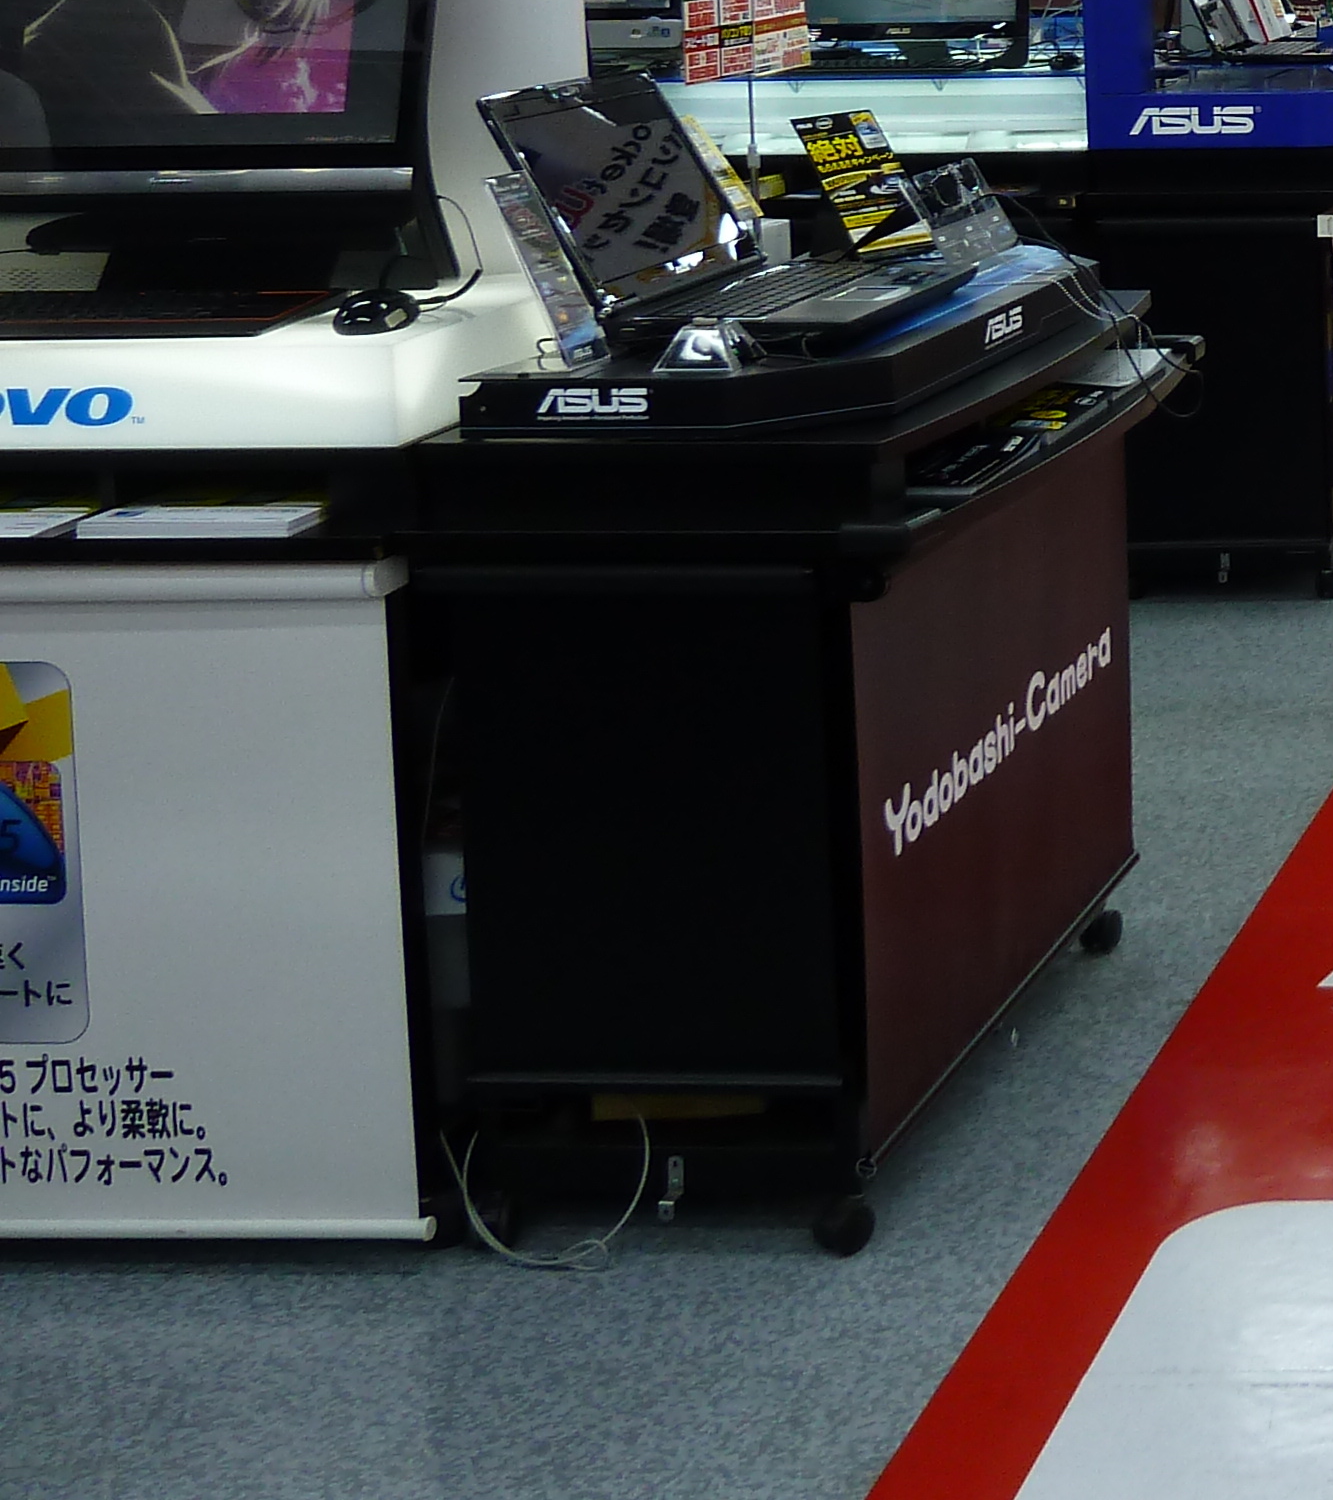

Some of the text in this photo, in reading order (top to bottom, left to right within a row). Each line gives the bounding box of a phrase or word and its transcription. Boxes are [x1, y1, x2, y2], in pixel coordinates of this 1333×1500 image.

[1129, 105, 1255, 136] ASUS
[806, 134, 864, 163] 絶対
[985, 307, 1024, 340] ASUS
[537, 388, 650, 414] ASUS
[885, 625, 1112, 857] Yodobashi-Camera
[25, 1054, 175, 1096] プロセッサー
